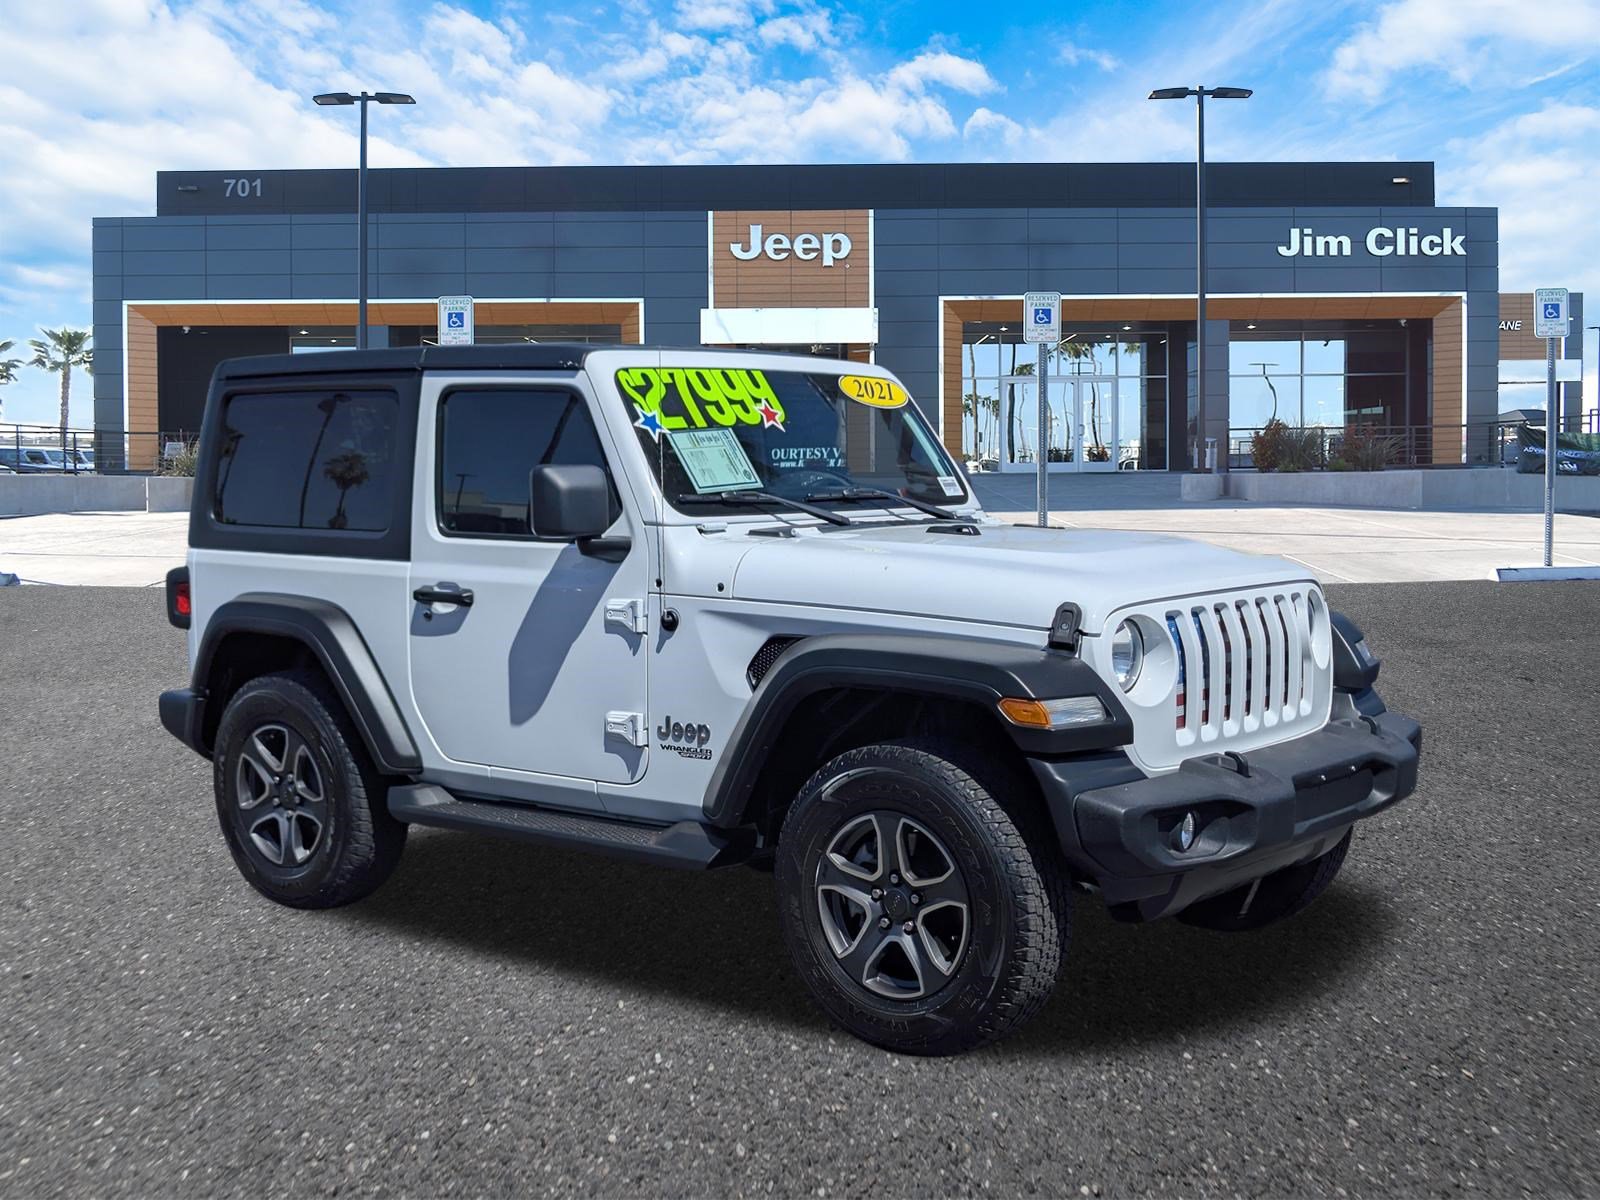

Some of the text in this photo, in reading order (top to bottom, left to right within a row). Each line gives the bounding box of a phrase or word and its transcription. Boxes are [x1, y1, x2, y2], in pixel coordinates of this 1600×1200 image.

[223, 178, 262, 197] 701
[729, 223, 852, 267] Jeep
[1277, 227, 1467, 257] Jim Click
[853, 380, 893, 400] 2021
[657, 715, 710, 748] Jeep
[660, 744, 712, 755] WRANGLER
